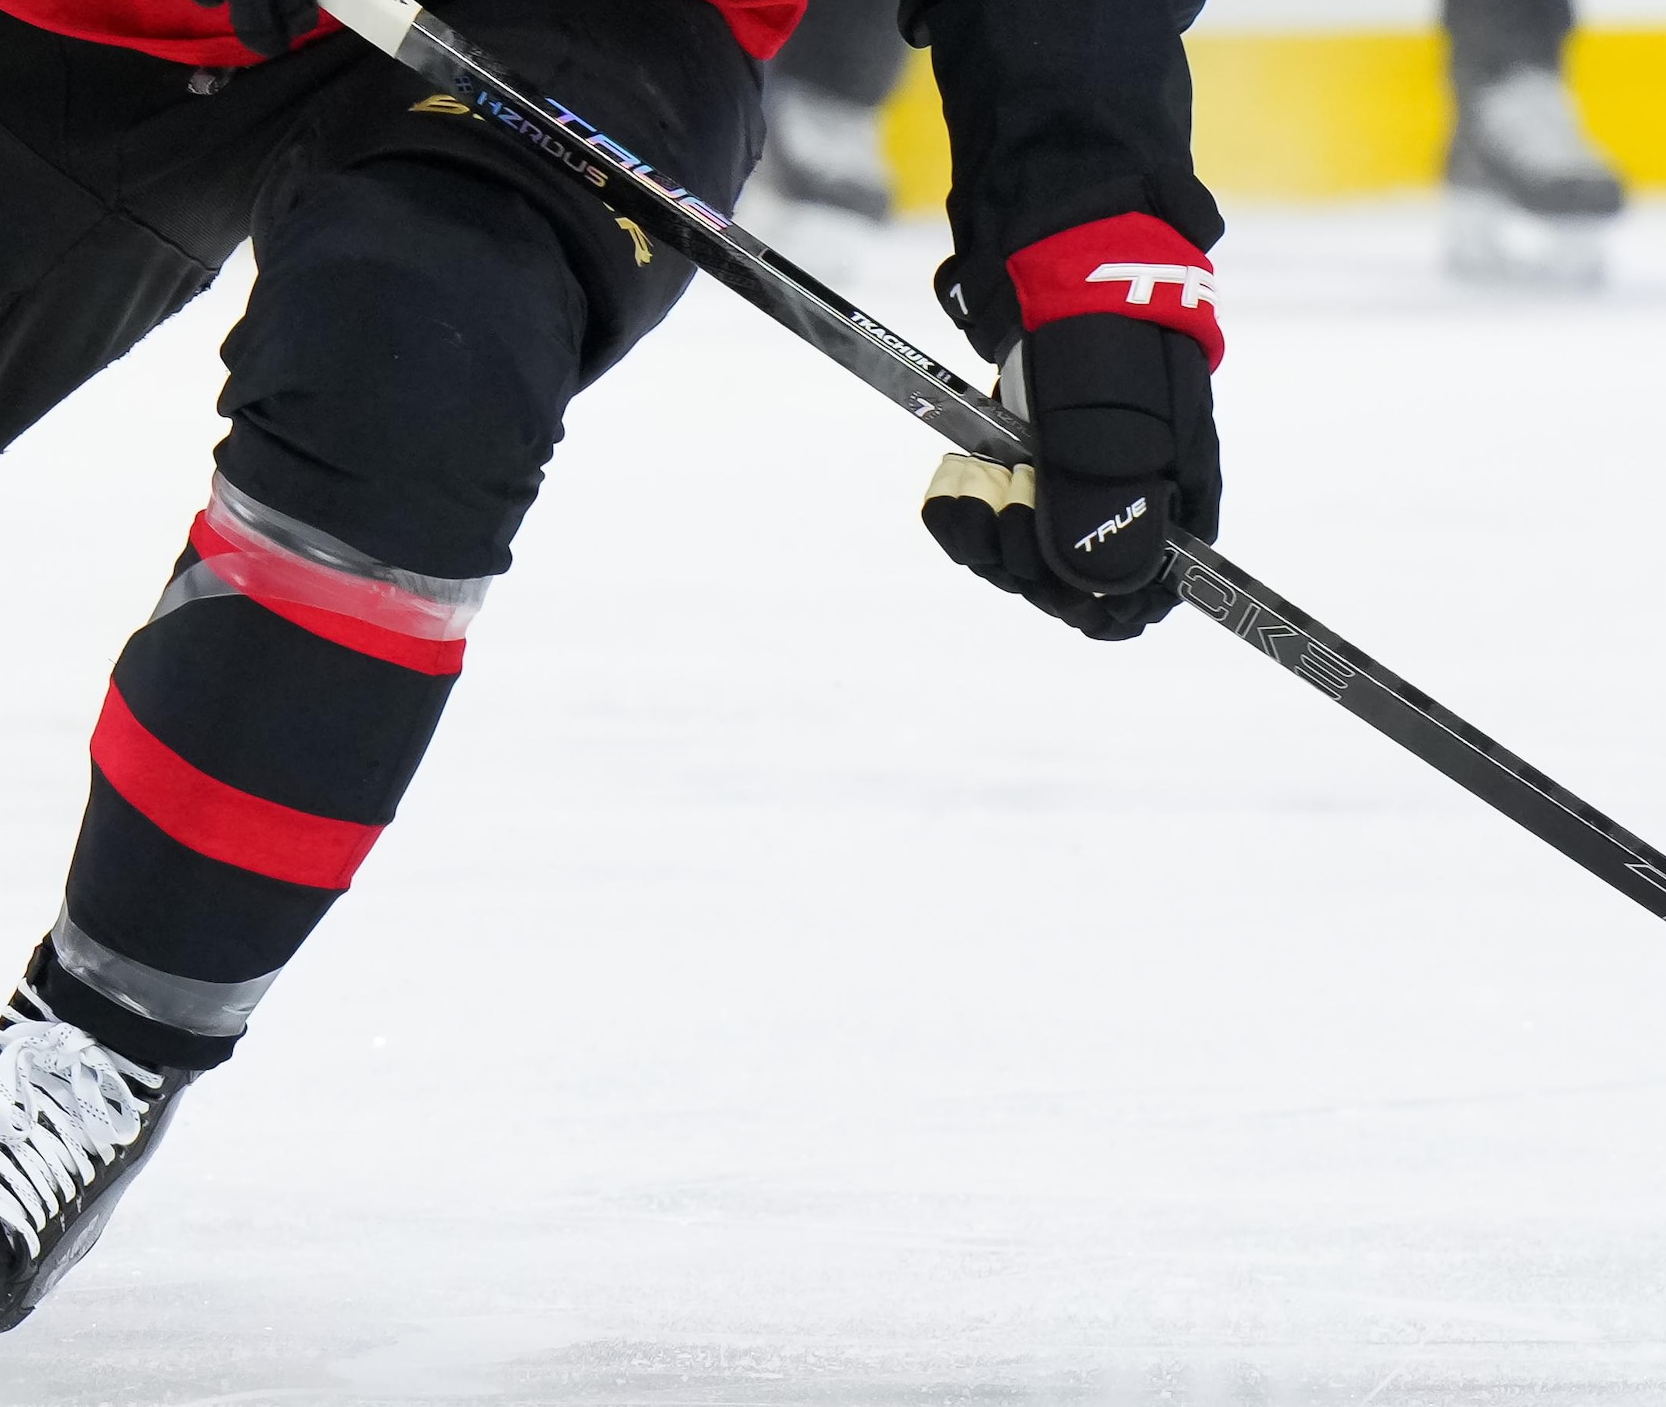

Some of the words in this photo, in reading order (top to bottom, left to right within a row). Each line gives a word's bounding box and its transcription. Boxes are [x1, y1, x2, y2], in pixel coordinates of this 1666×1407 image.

[544, 96, 733, 232] TRUE
[850, 310, 934, 371] TKACHUK
[1074, 496, 1148, 553] TRUE
